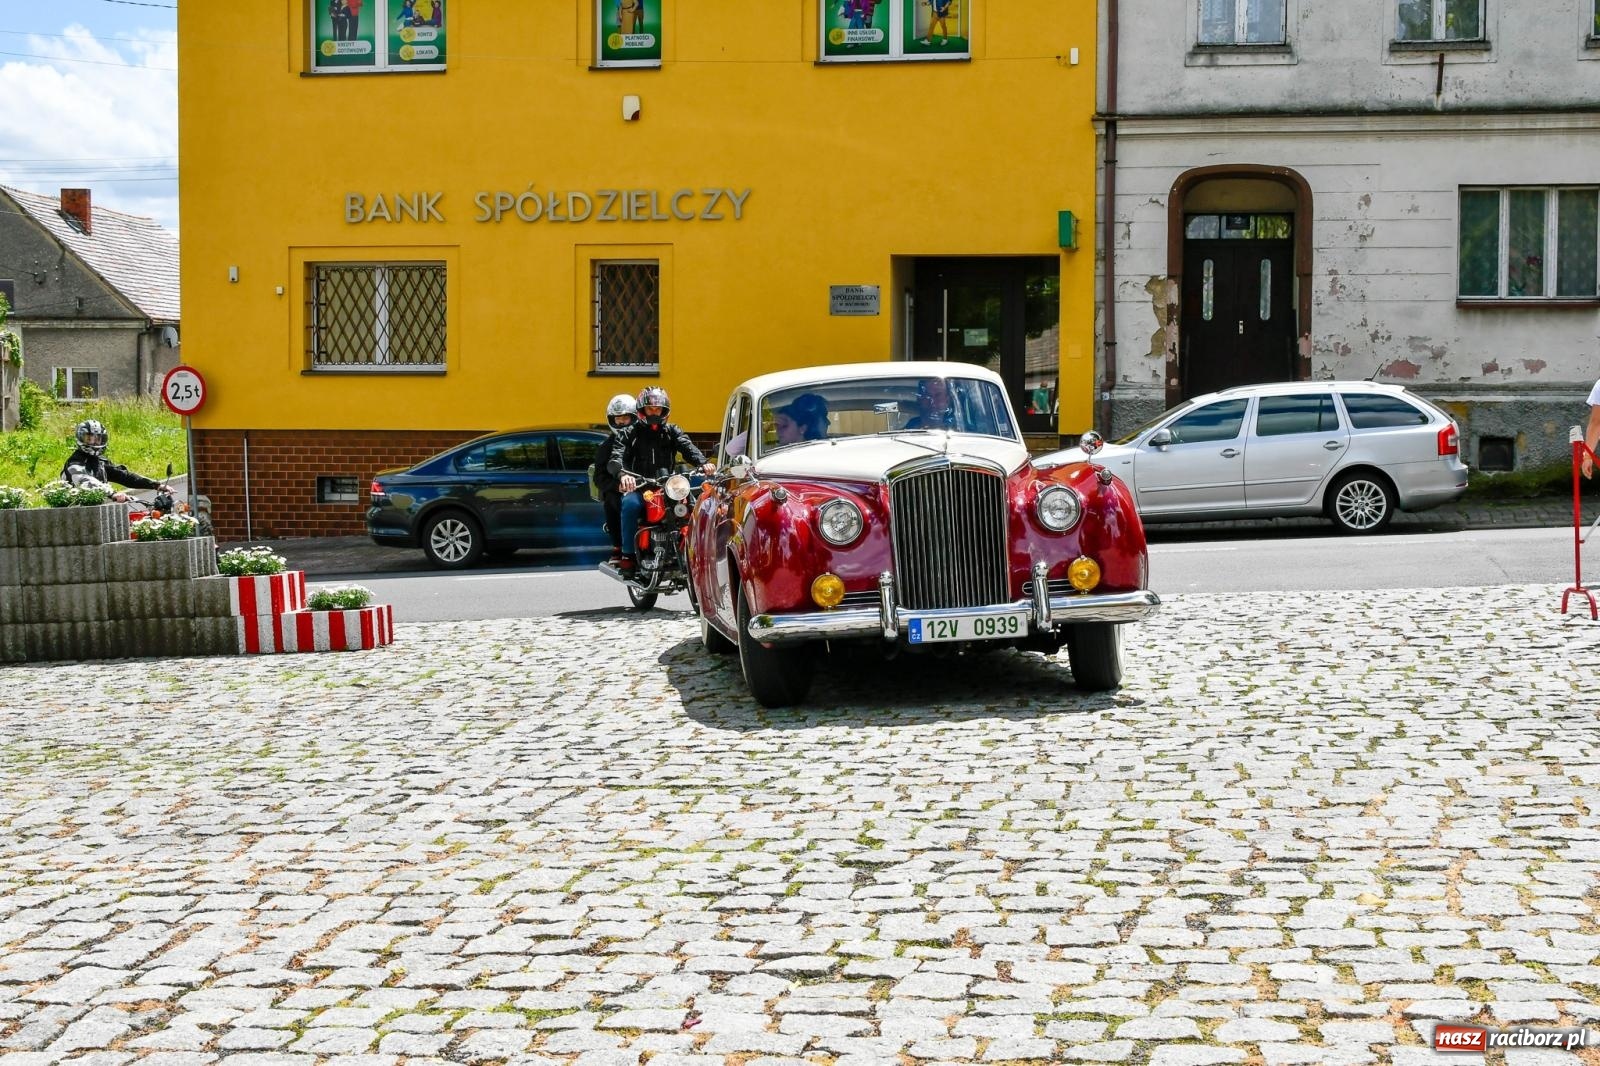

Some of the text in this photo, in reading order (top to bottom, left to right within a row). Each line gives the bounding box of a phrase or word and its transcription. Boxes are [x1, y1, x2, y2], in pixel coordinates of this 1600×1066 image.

[344, 183, 752, 223] BANK SPÓŁDZIELCZY
[926, 615, 1019, 639] 12V 0939
